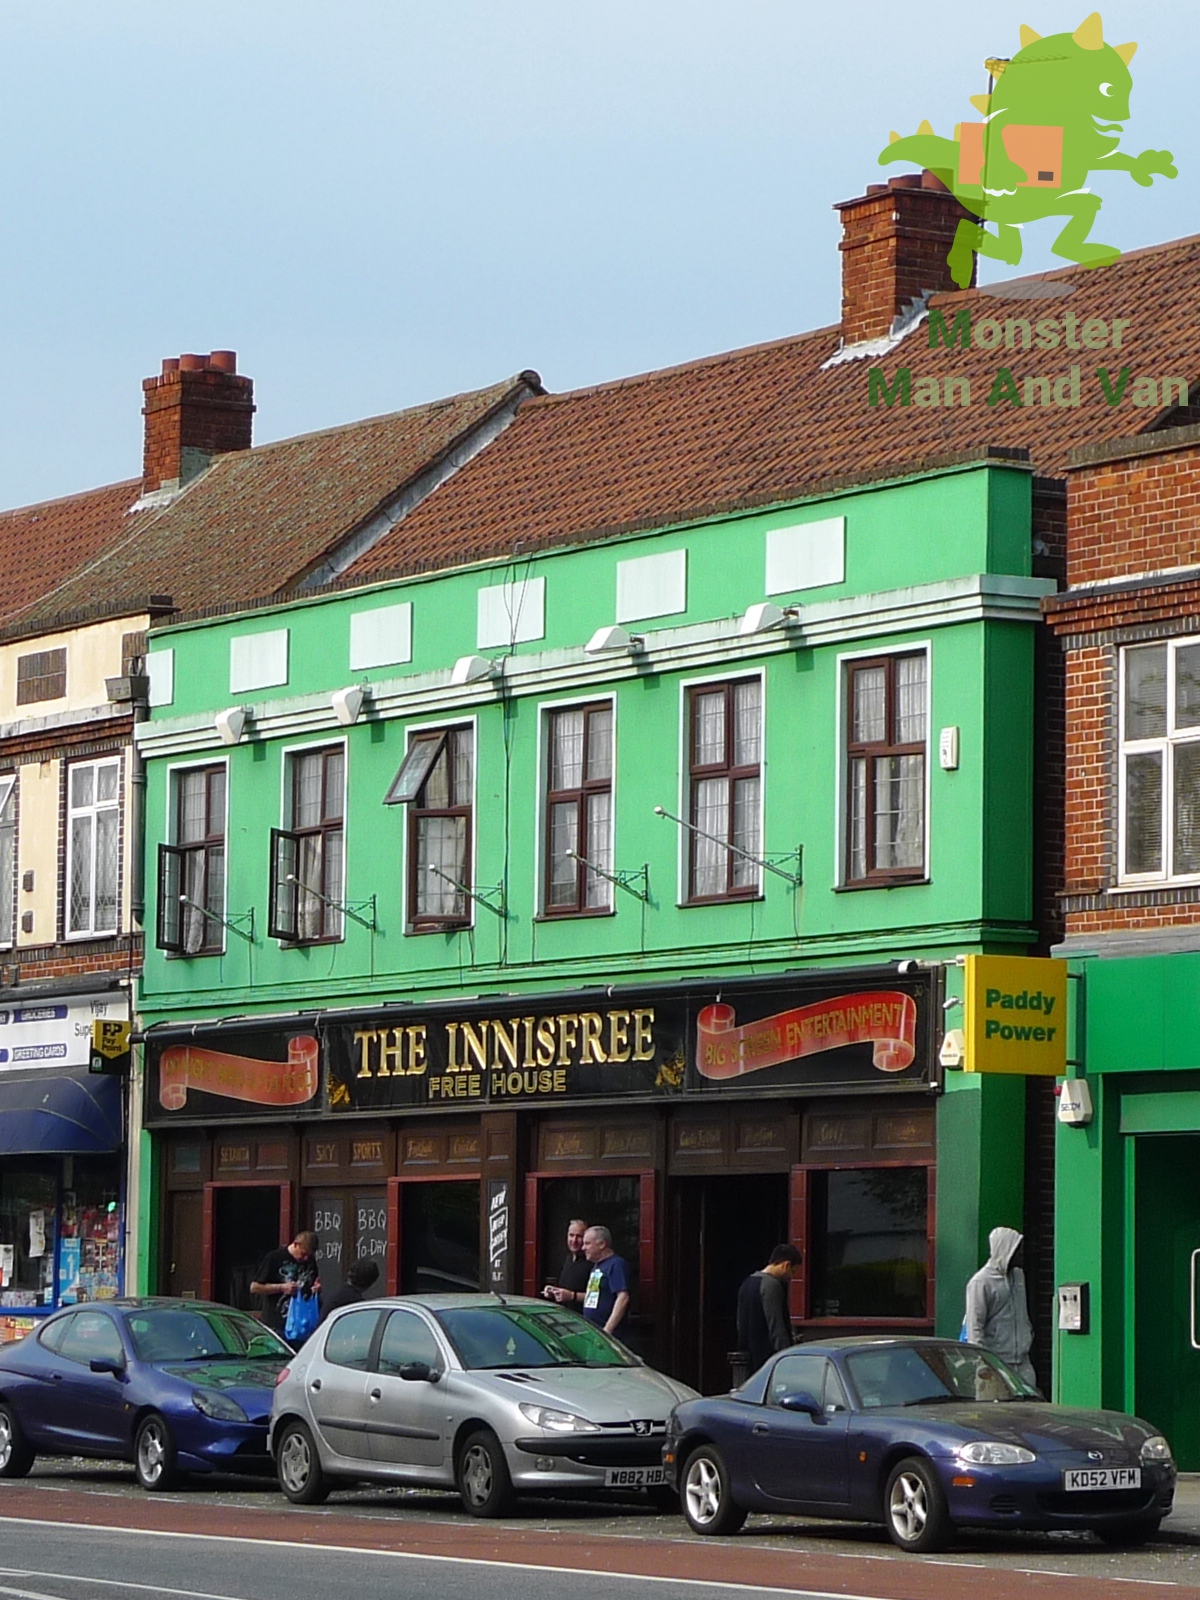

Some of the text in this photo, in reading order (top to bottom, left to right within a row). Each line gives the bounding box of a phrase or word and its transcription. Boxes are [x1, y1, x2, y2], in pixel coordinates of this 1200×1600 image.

[985, 988, 1057, 1016] Paddy
[102, 1036, 116, 1044] Pay
[704, 1043, 726, 1065] BIG
[785, 1002, 904, 1046] ENTERTAINMENT
[985, 1020, 1057, 1042] Power
[14, 1045, 65, 1060] GREETING CARDS
[353, 1007, 656, 1078] THE INNISFREE
[428, 1070, 567, 1098] FREE HOUSE
[315, 1142, 382, 1161] SKY SPORTS
[315, 1211, 341, 1232] BBQ
[358, 1208, 387, 1231] BBQ
[1070, 1469, 1136, 1487] KD52 VFM
